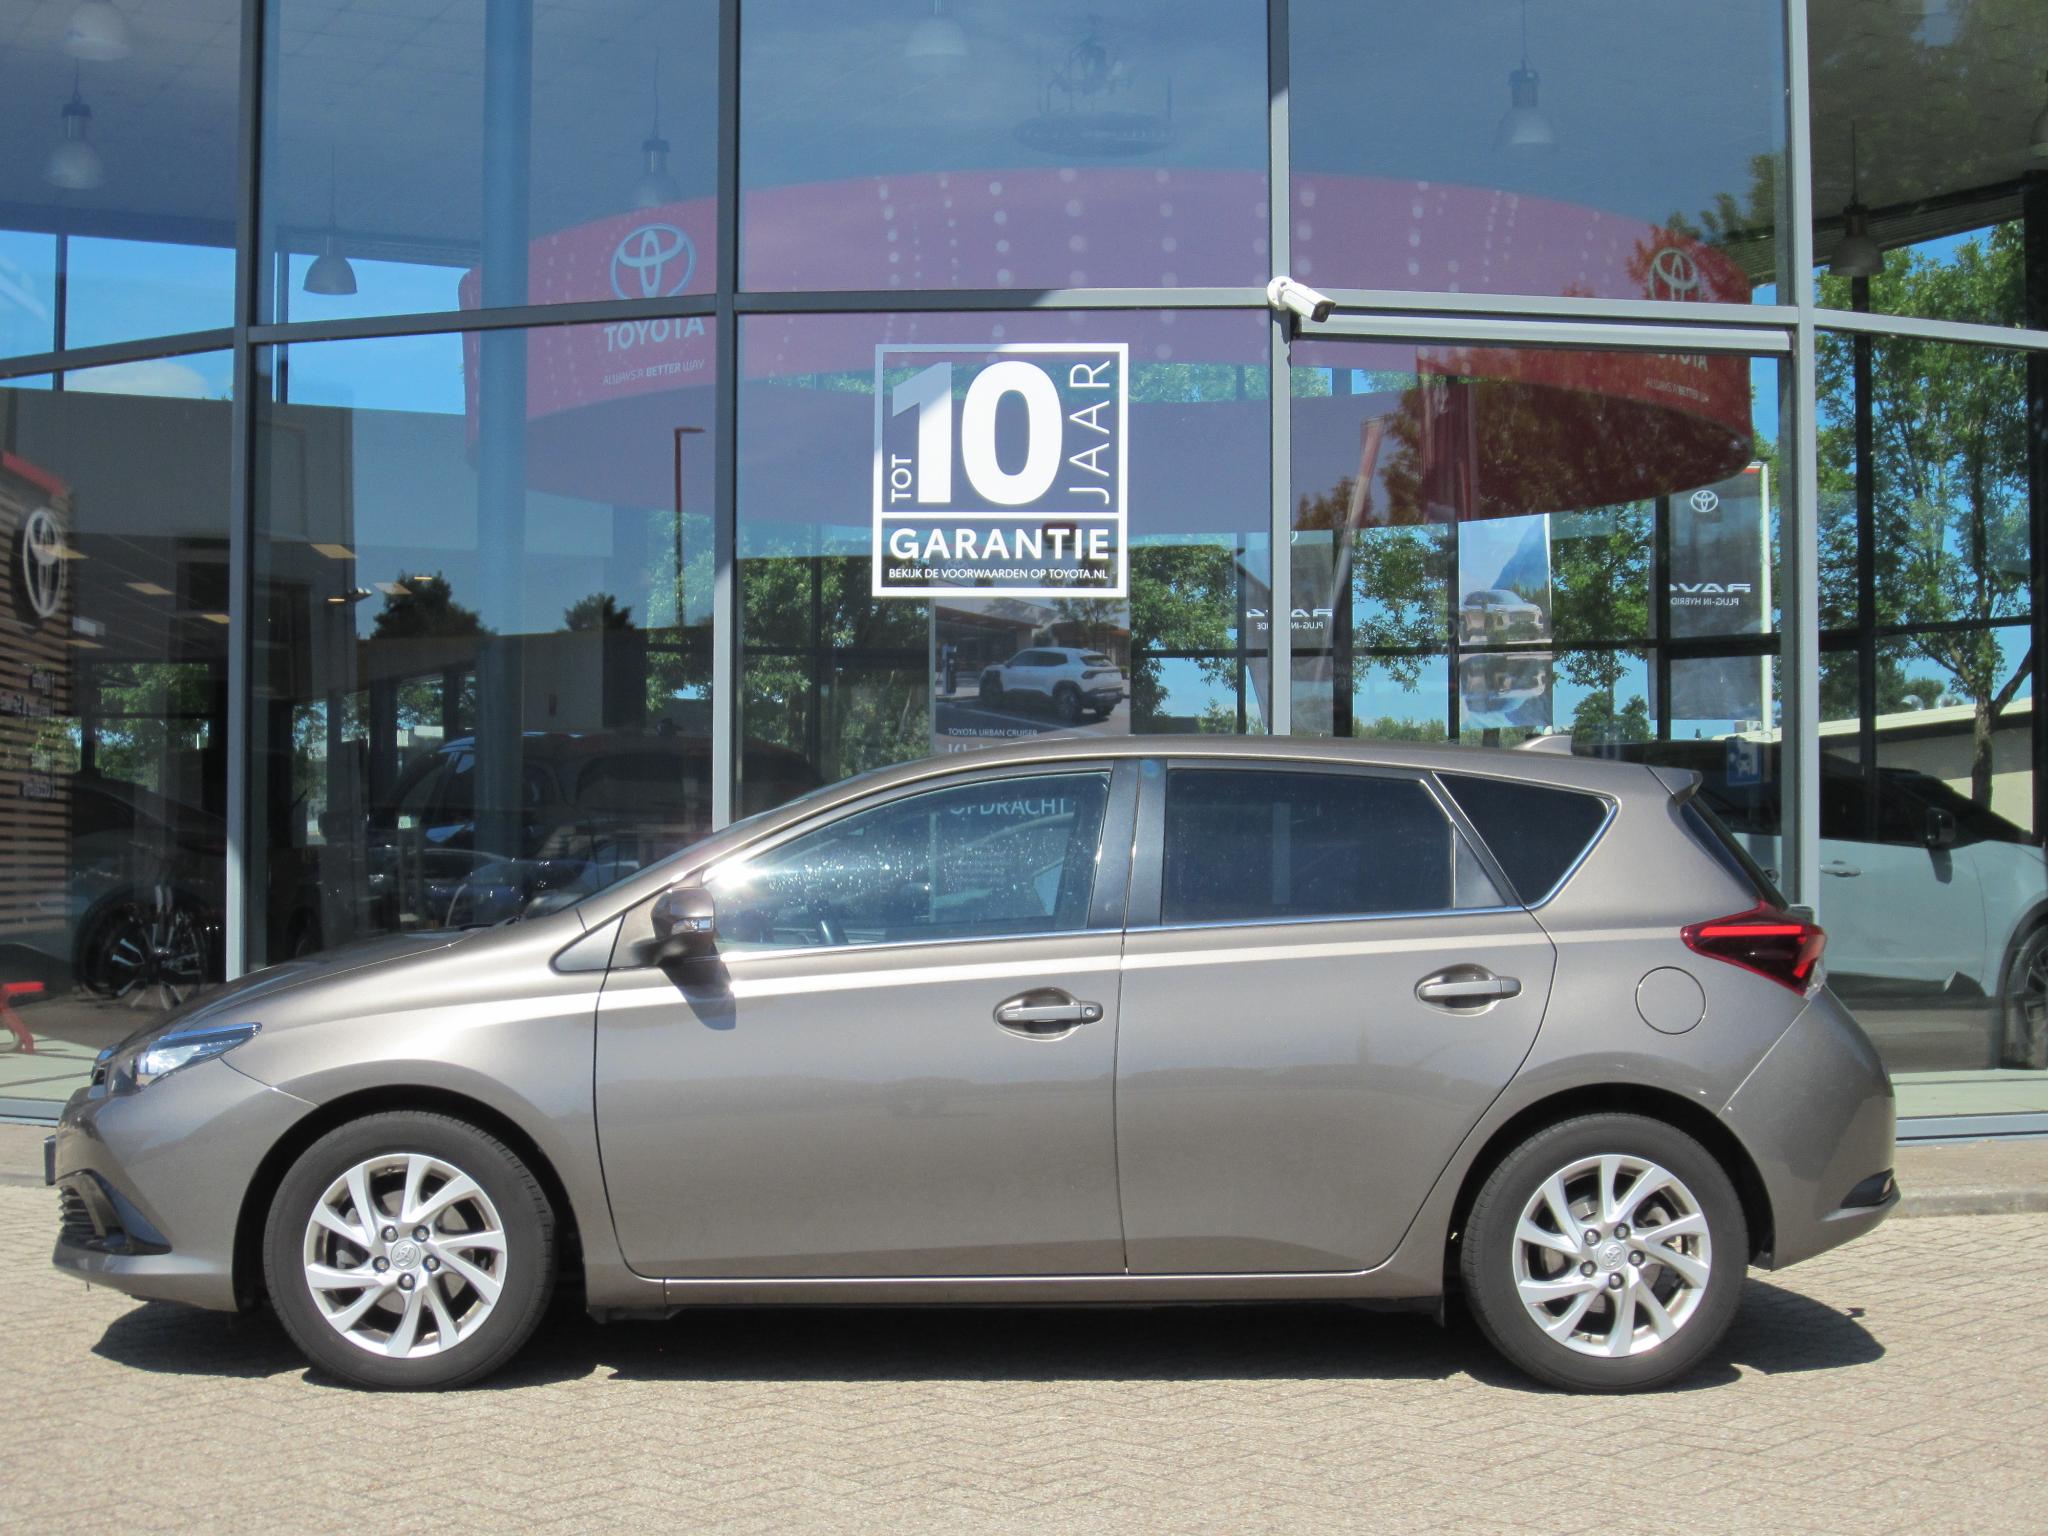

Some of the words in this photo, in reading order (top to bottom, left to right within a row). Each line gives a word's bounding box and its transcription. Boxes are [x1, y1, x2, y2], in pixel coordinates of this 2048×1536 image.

[603, 317, 705, 352] TOYOTA
[646, 362, 681, 377] BETTER
[892, 360, 1063, 505] 10
[1069, 360, 1110, 505] JAAR
[891, 454, 912, 503] TOT
[889, 528, 1110, 560] GARANTIE
[889, 568, 923, 579] BEKIJK
[925, 568, 939, 579] DE
[941, 568, 1028, 579] VOORWAARDEN
[1030, 568, 1047, 579] OP
[1048, 568, 1108, 579] TOYOTA.NL
[948, 728, 977, 736] TOYOTA
[978, 728, 1005, 736] URBAN
[1006, 729, 1038, 737] CRUISER
